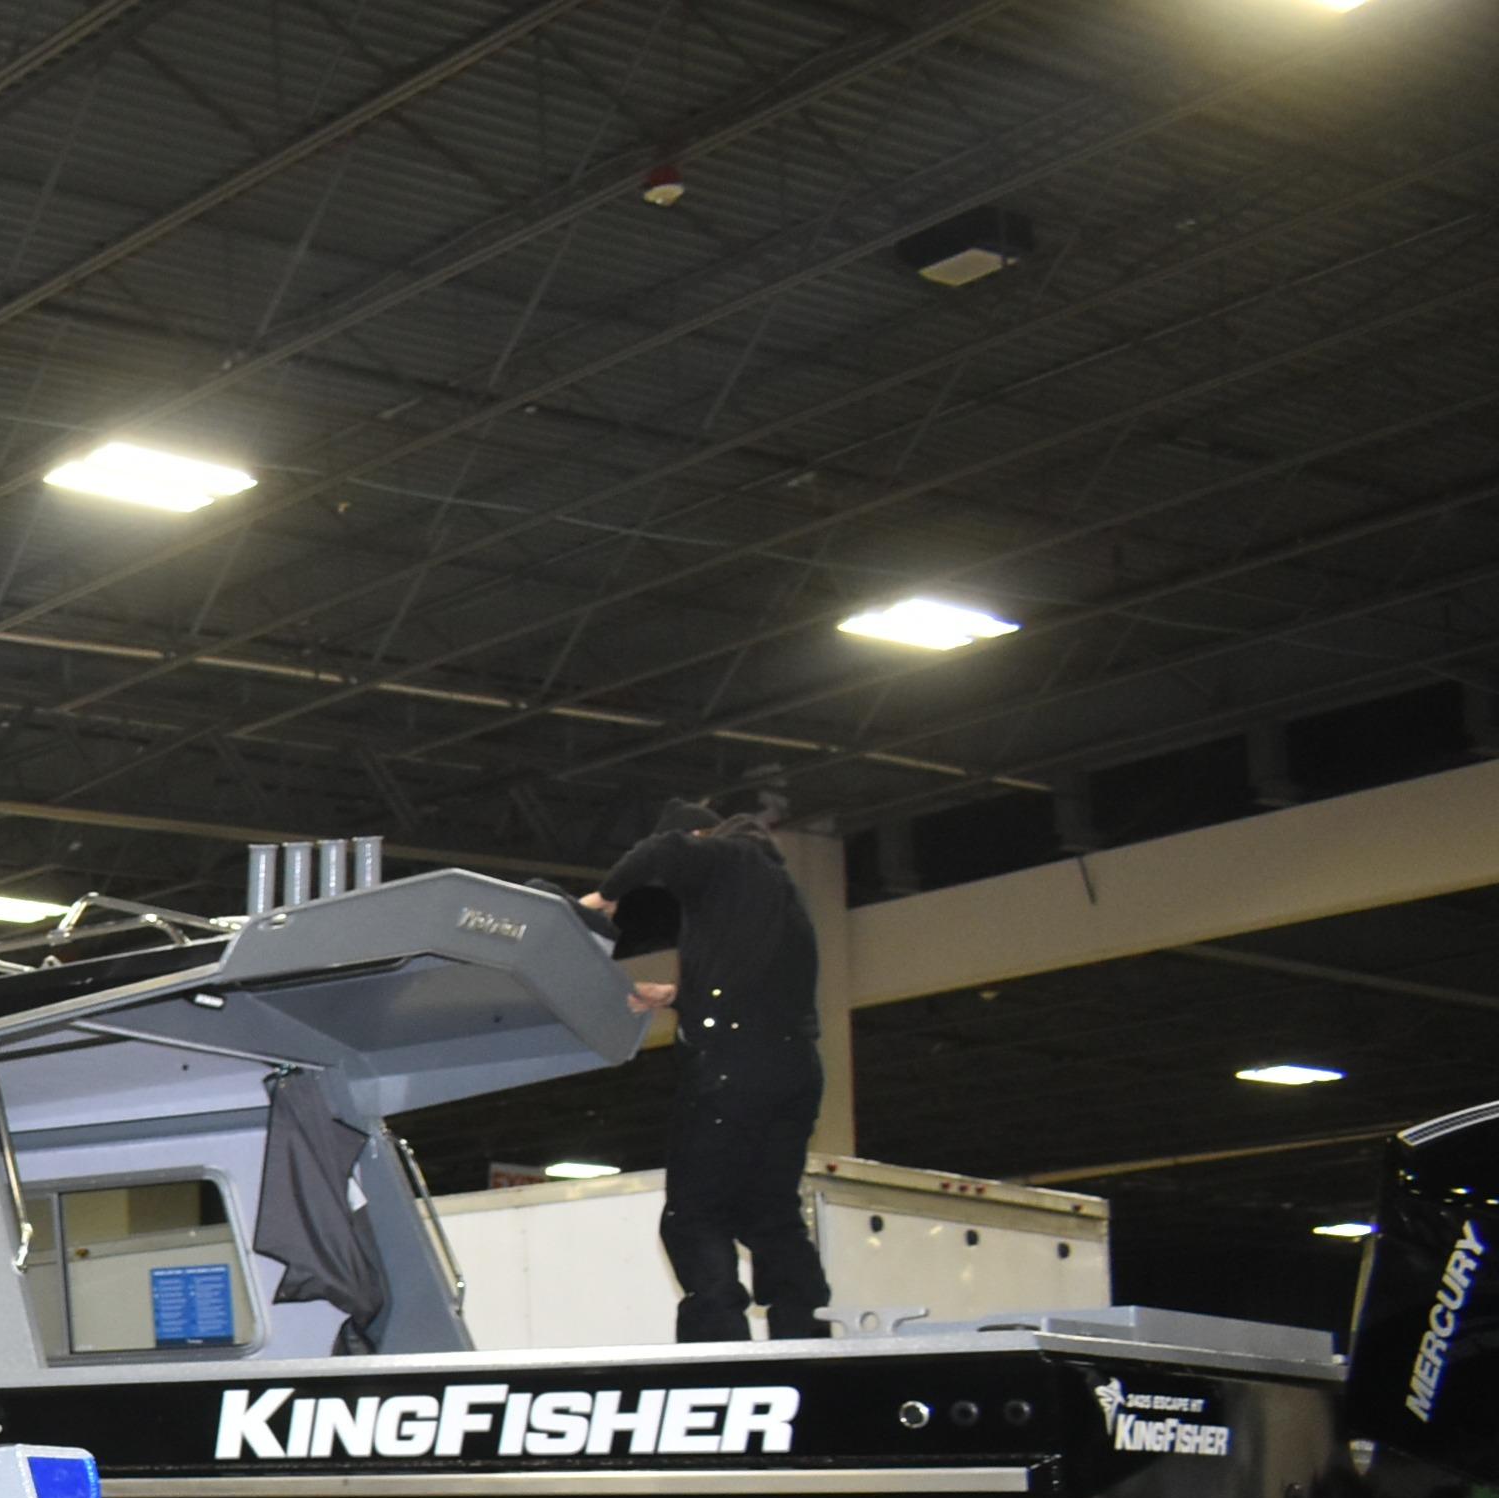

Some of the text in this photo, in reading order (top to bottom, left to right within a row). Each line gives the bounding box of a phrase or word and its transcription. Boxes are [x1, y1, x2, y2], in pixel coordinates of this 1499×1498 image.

[1405, 1220, 1485, 1422] MERCURY
[214, 1384, 801, 1459] KINGFISHER
[1114, 1414, 1229, 1455] KINGFISHER
